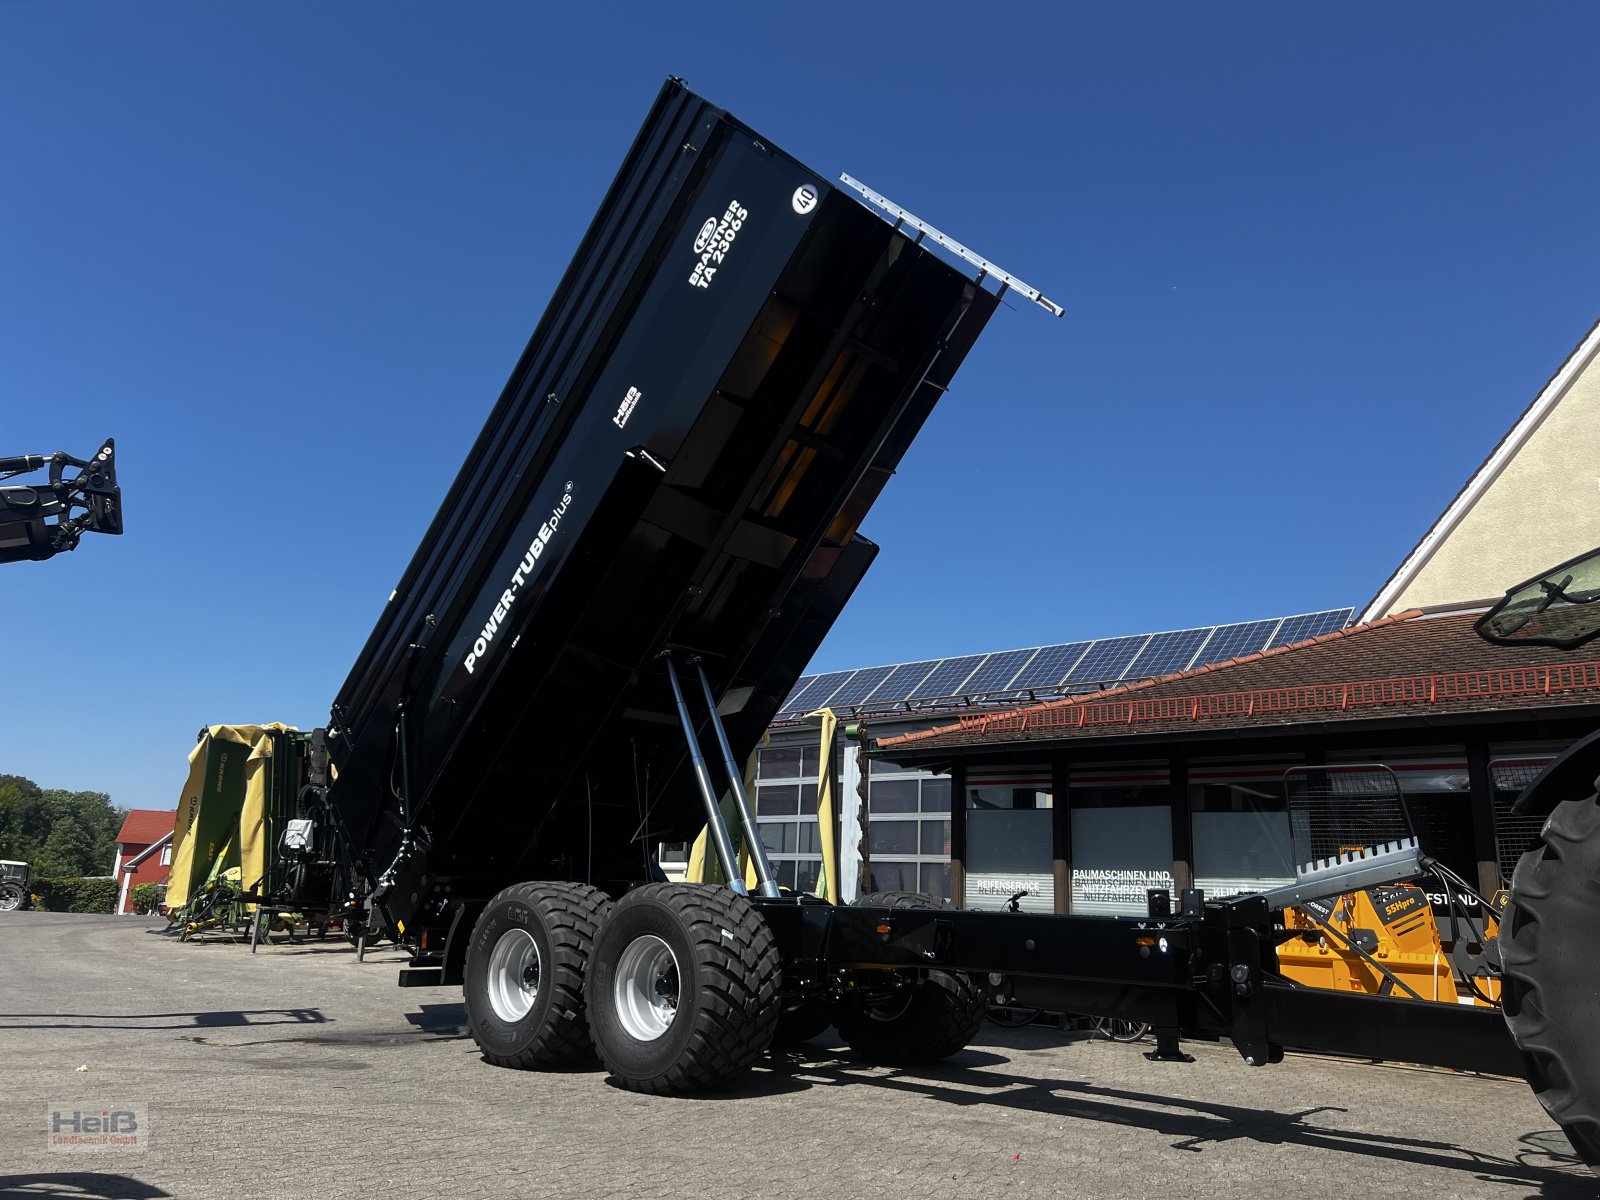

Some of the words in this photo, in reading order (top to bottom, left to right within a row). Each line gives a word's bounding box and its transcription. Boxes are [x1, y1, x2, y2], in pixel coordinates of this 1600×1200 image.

[797, 188, 814, 209] 40
[688, 199, 741, 286] BRANTNER
[697, 266, 717, 289] TA
[712, 206, 748, 265] 23065
[618, 391, 641, 428] Landtechnik
[1072, 869, 1146, 880] BAUMASCHINEN
[1149, 870, 1170, 880] UND
[977, 880, 1040, 891] REIFENSERVICE
[1082, 884, 1161, 894] NUTZFAHRZEU
[1384, 896, 1415, 916] 55Hpro
